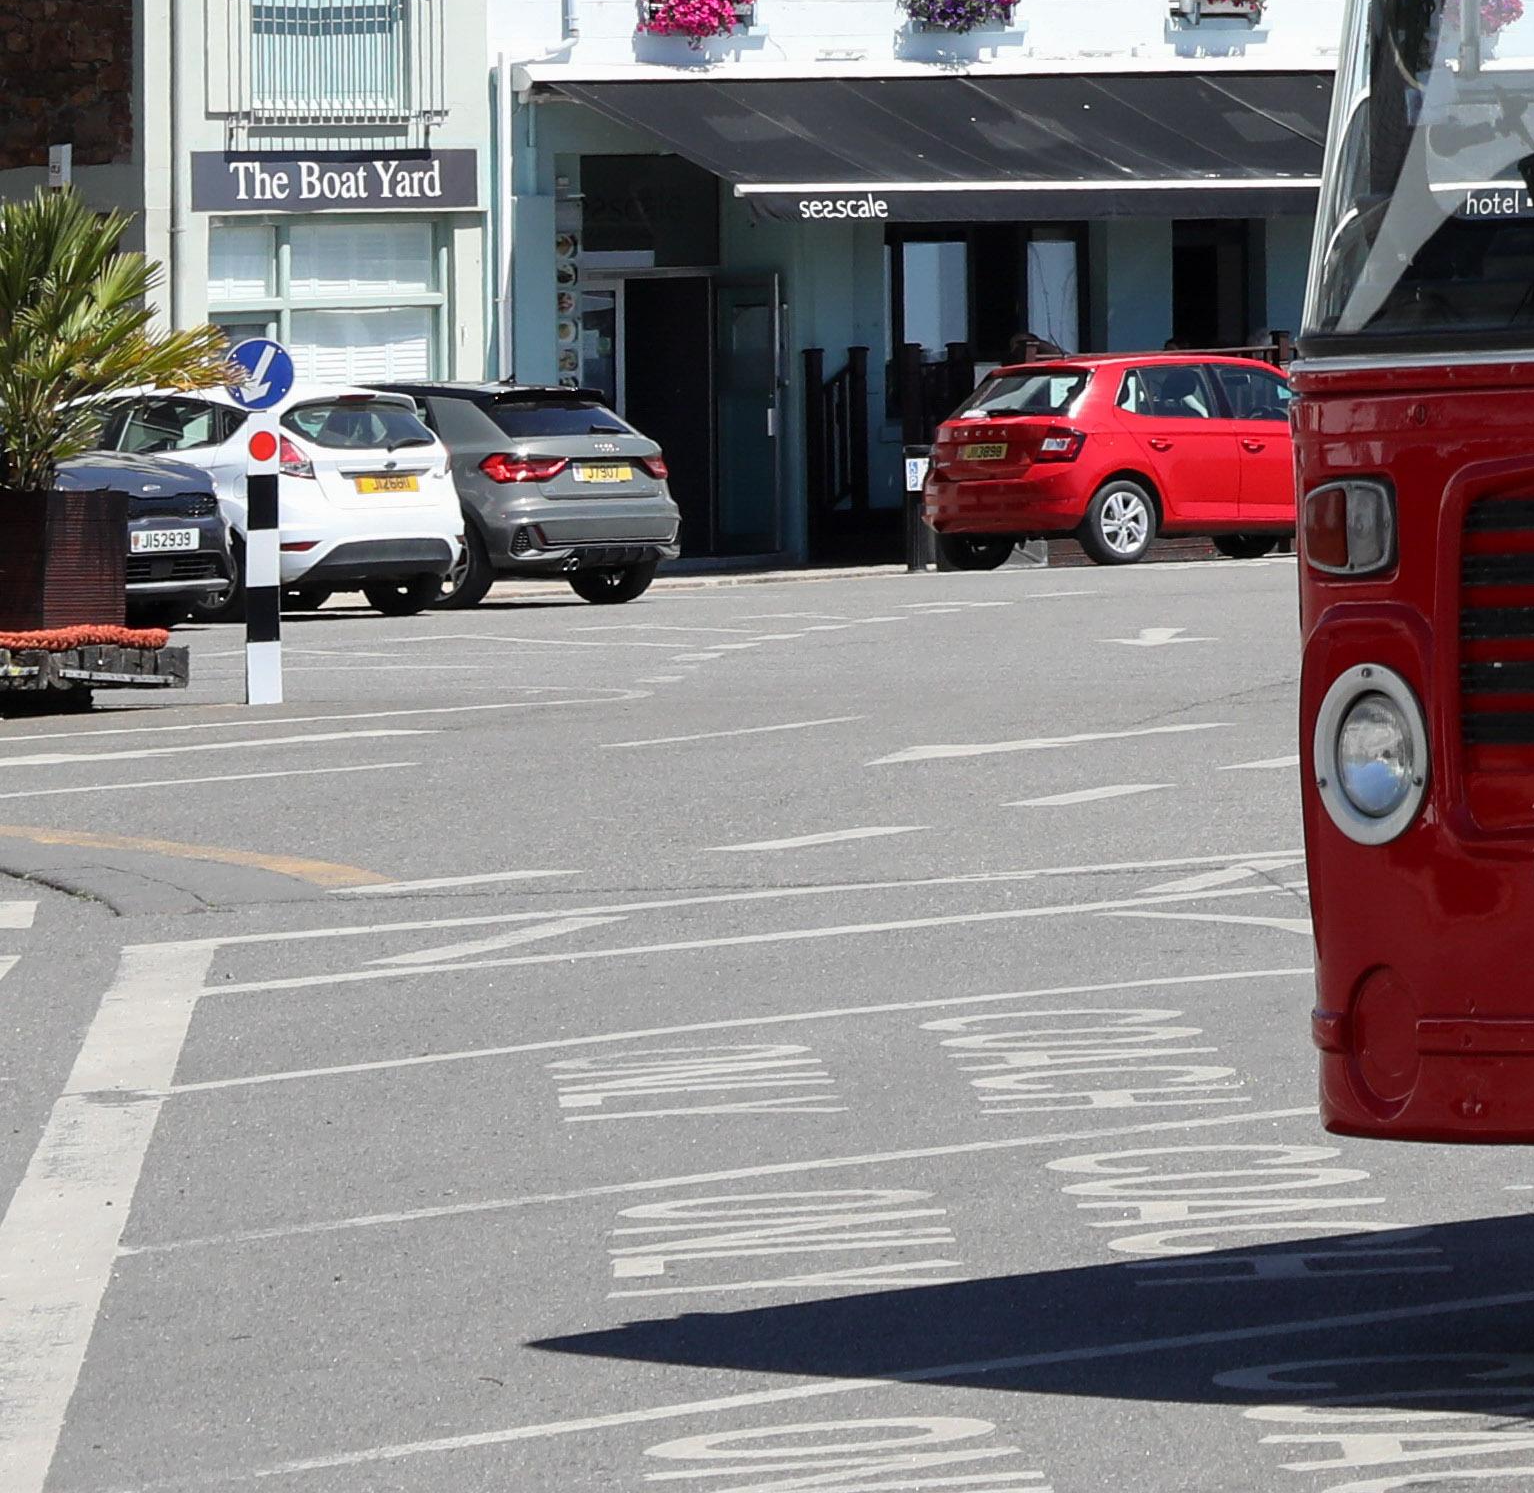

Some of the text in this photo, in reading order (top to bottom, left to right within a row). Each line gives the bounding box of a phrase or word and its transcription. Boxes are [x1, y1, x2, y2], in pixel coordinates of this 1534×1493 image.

[230, 161, 442, 201] The Boat Yard
[1466, 190, 1519, 215] hotel
